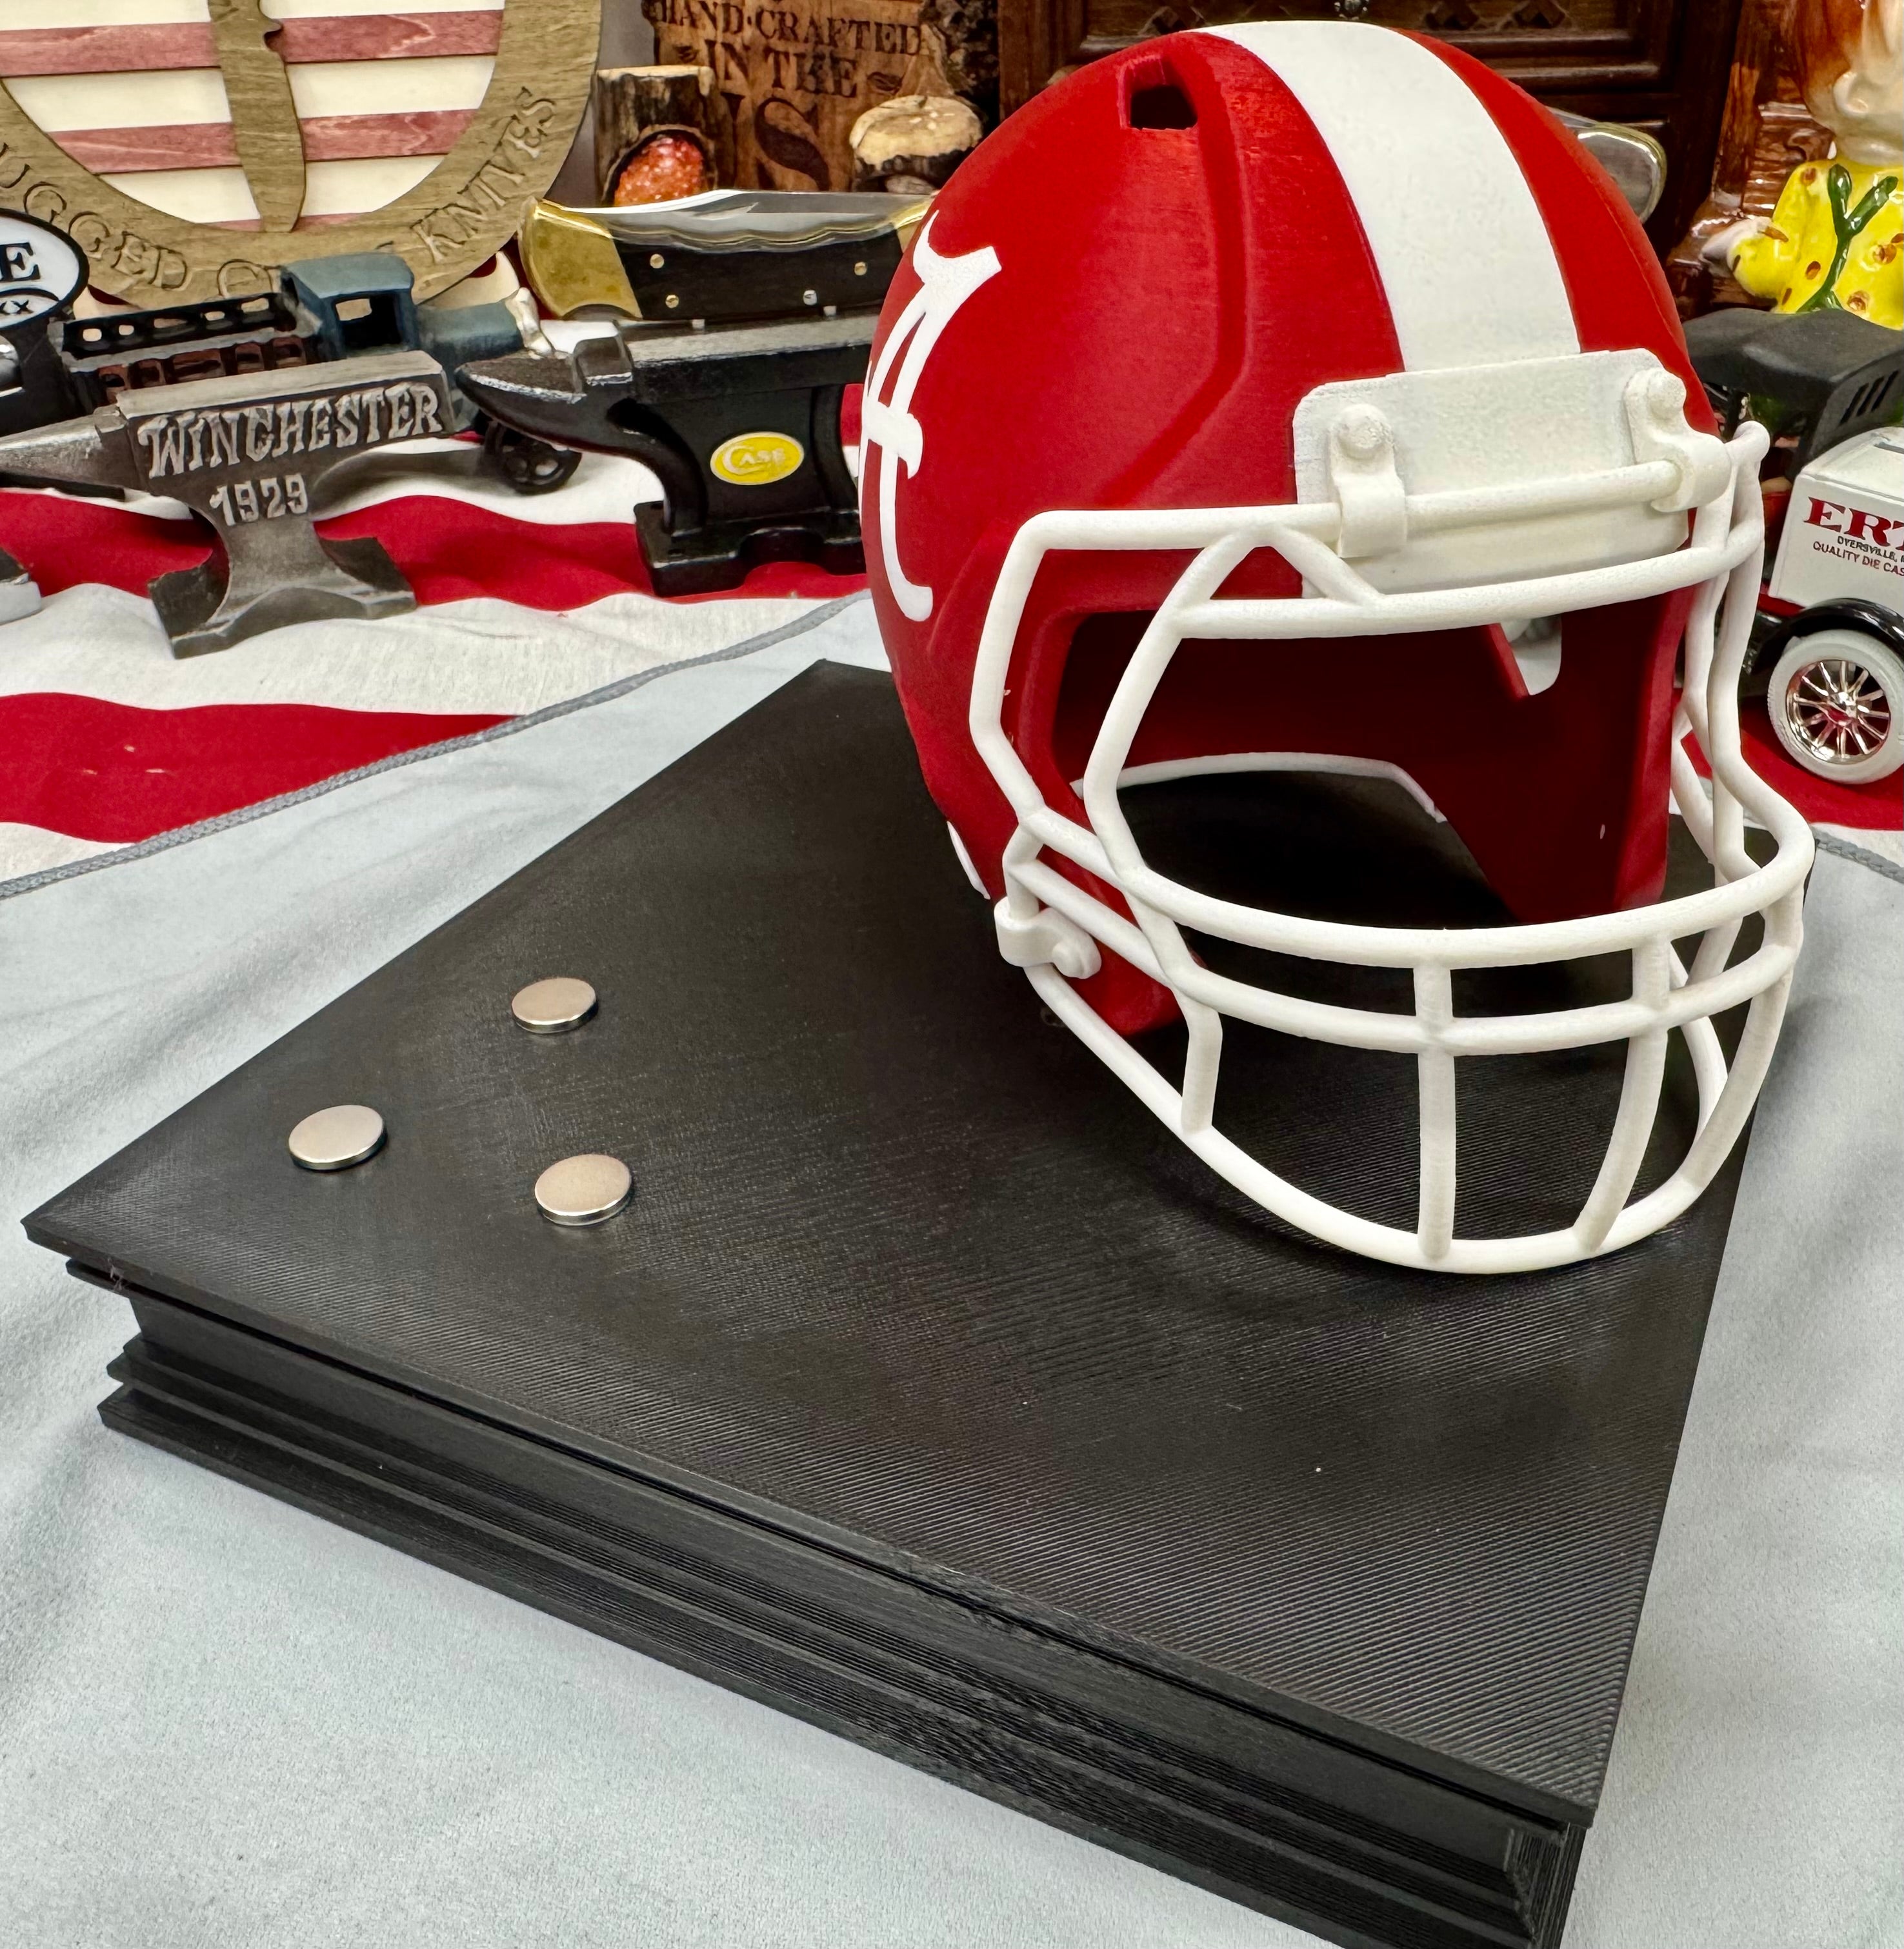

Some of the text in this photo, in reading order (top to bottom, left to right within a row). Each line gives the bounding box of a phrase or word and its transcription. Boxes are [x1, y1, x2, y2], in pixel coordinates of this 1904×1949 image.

[705, 39, 857, 98] IN THE
[409, 86, 556, 263] KNIVES
[137, 382, 443, 479] WINCHESTER
[209, 473, 308, 526] 1929
[1813, 541, 1860, 563] QUALITY
[1862, 555, 1880, 569] DIE
